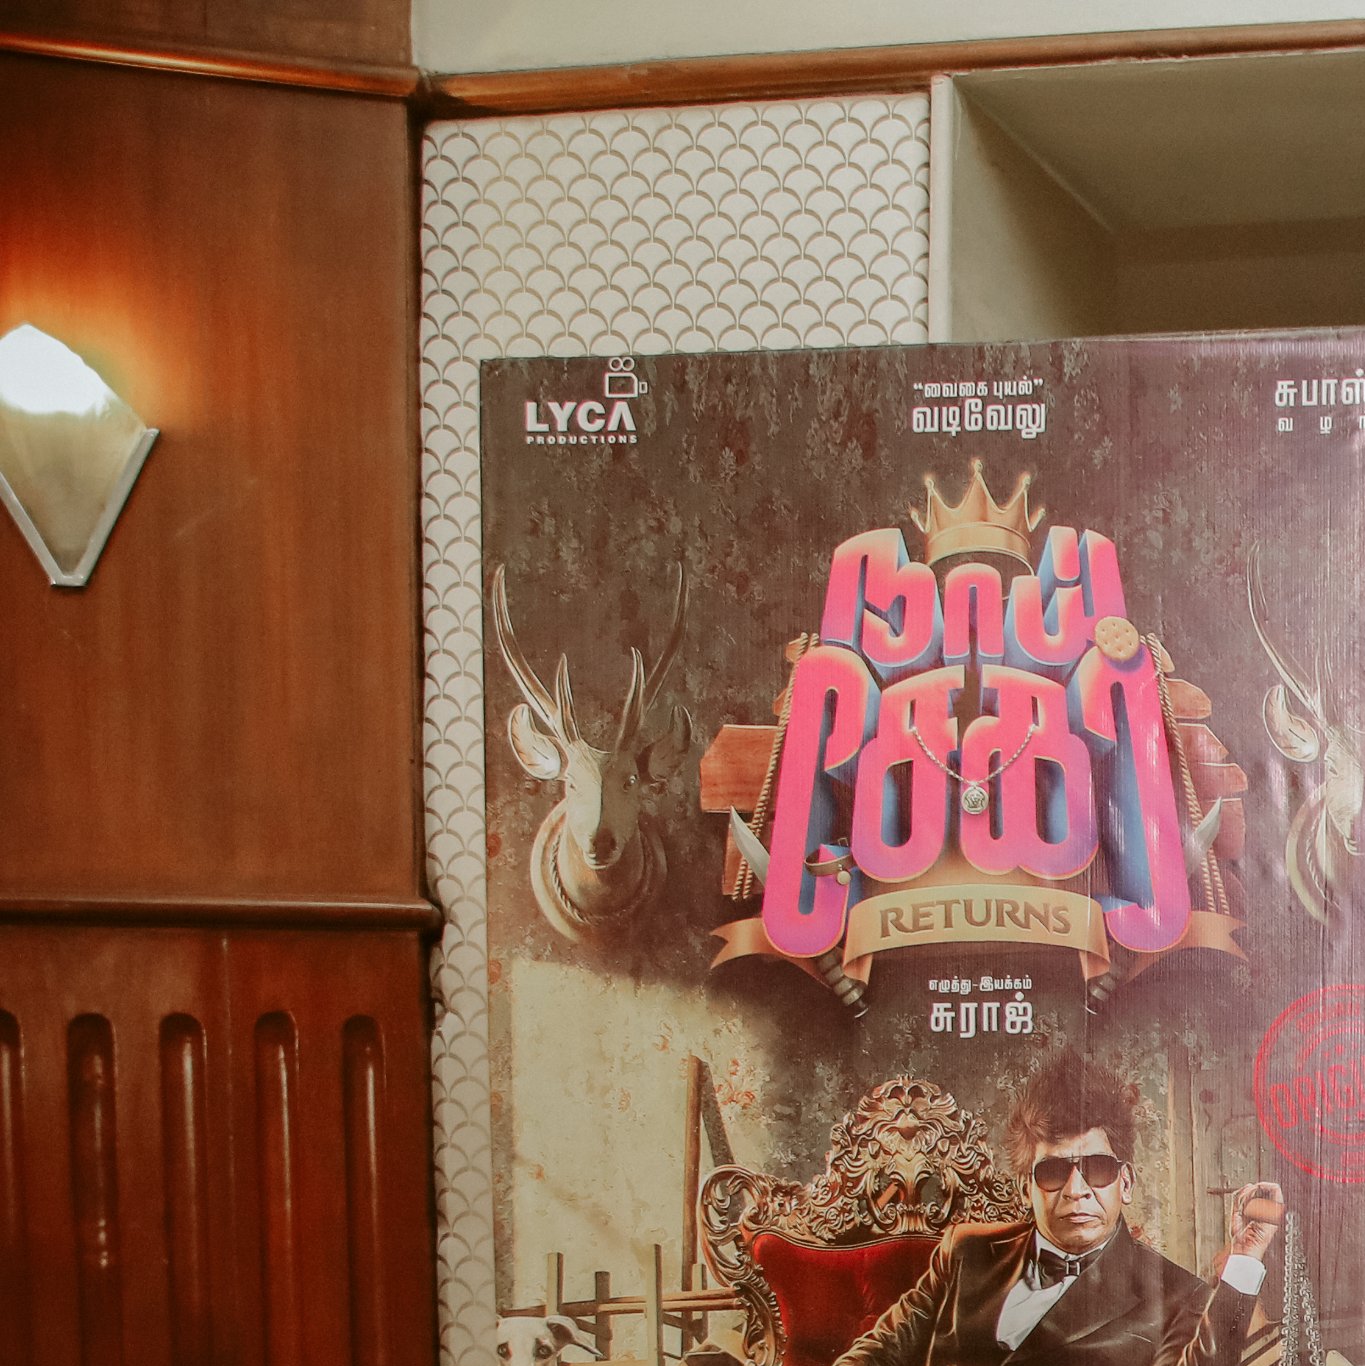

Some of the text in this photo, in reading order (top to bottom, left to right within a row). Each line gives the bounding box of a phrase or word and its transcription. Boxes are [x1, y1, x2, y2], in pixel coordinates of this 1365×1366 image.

[526, 400, 637, 432] LYCA
[912, 398, 1046, 439] வடிவேலு
[526, 435, 638, 445] PRODUCTIONS
[820, 525, 1128, 668] நாய்
[879, 898, 1072, 939] RETURNS
[930, 991, 1034, 1039] சுராஜ்
